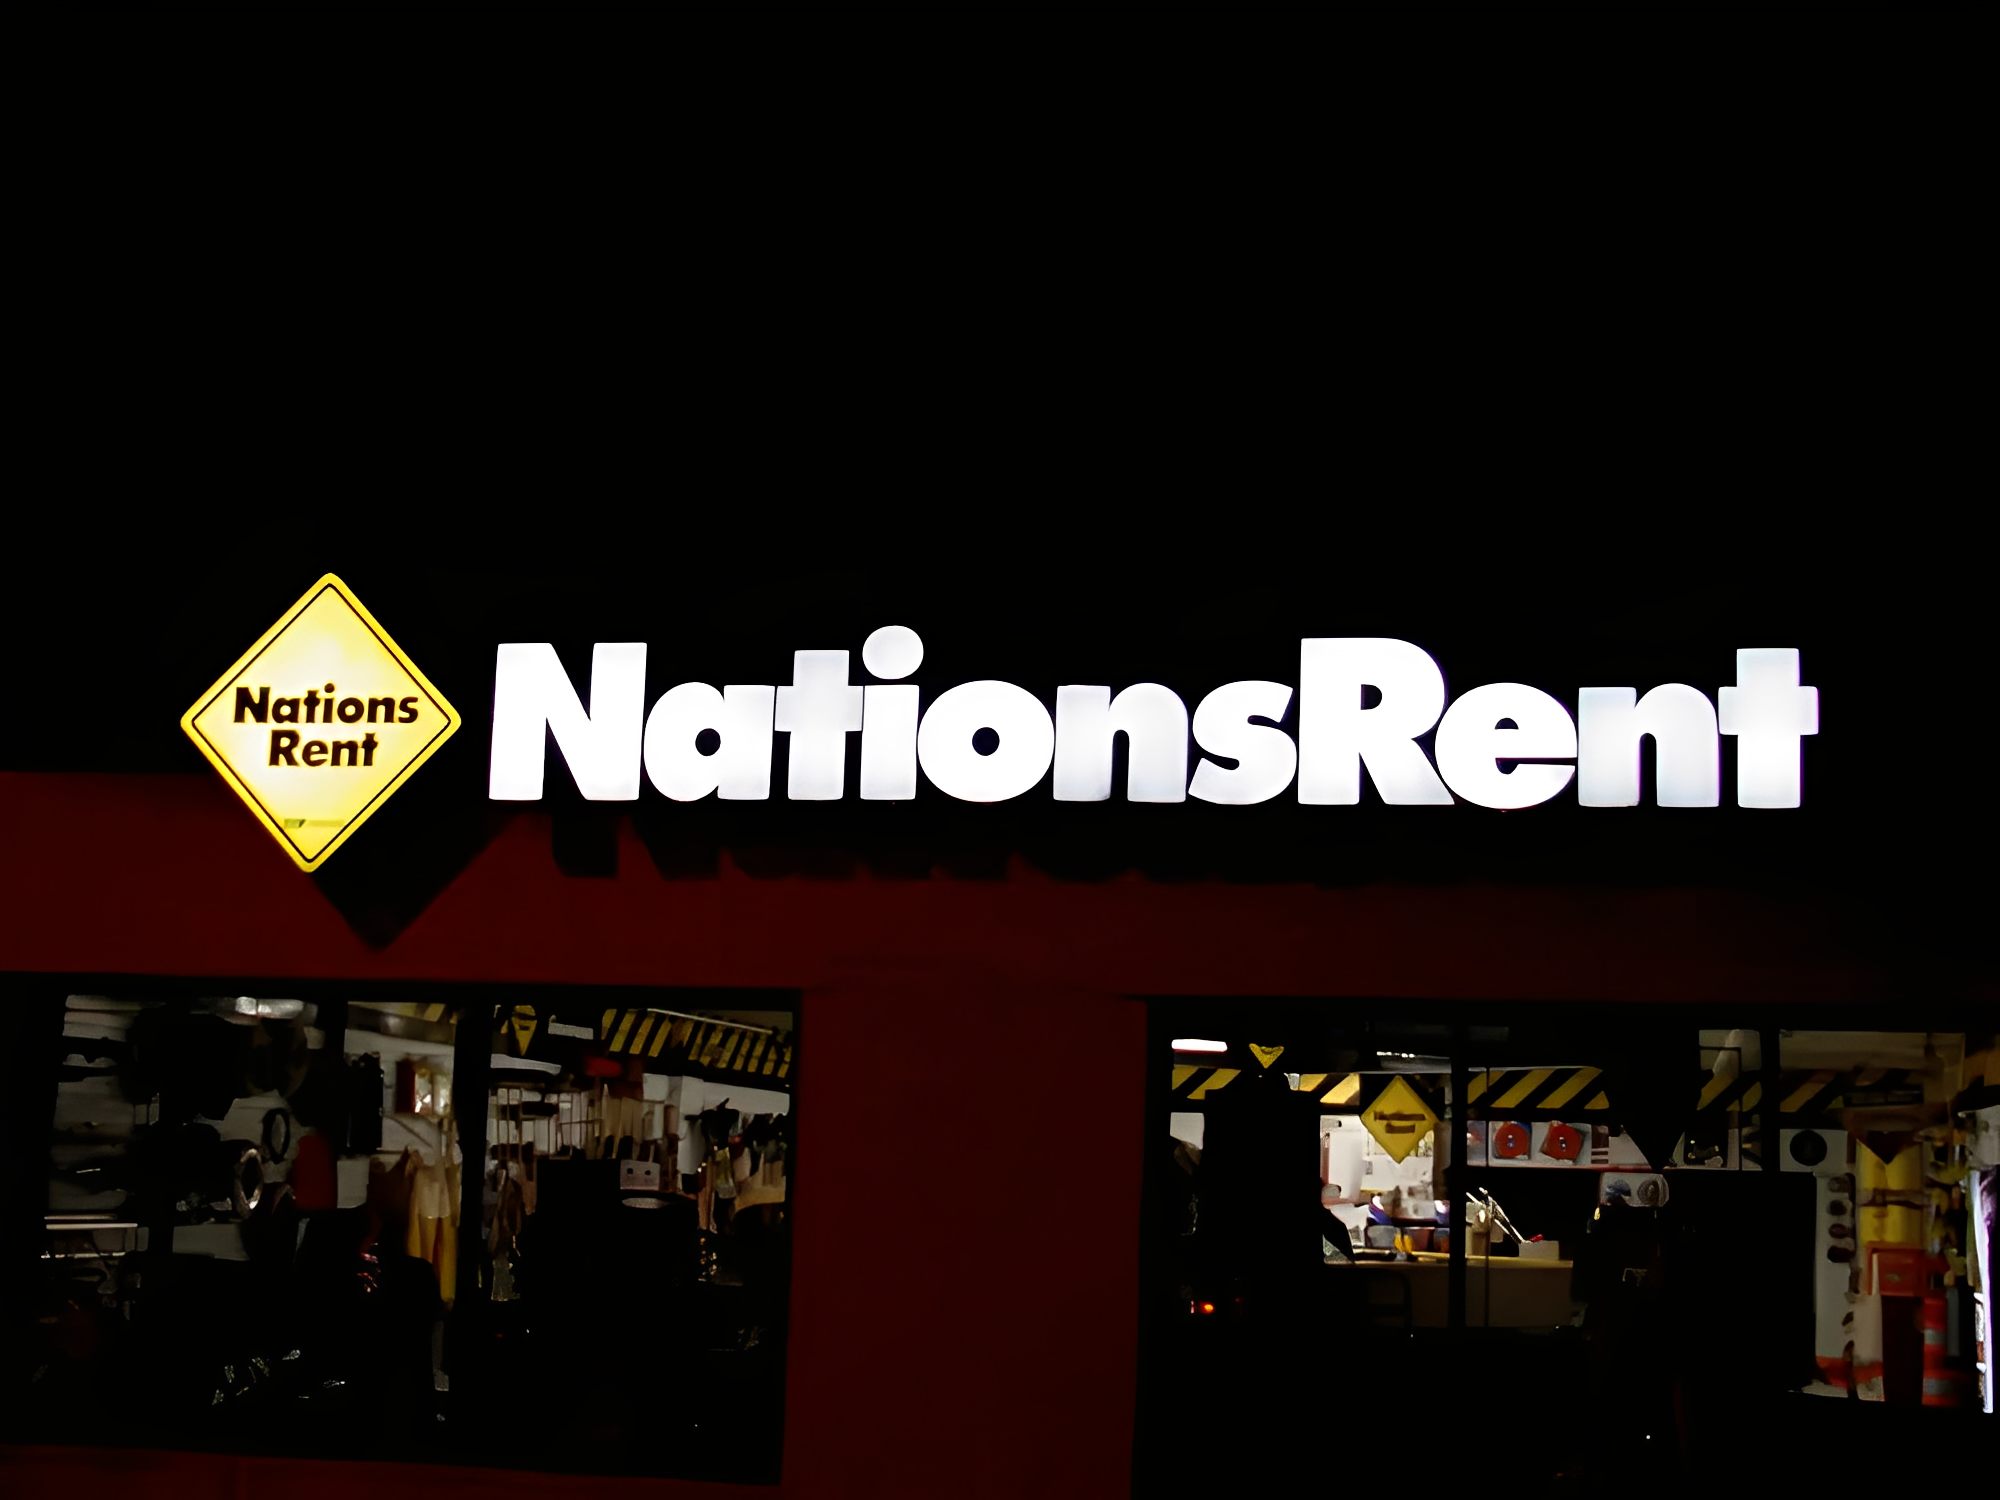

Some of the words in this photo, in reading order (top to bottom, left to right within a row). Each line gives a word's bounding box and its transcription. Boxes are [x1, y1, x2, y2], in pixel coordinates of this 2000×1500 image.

[233, 682, 419, 724] Nations
[489, 625, 1819, 809] NationsRent
[269, 729, 378, 767] Rent
